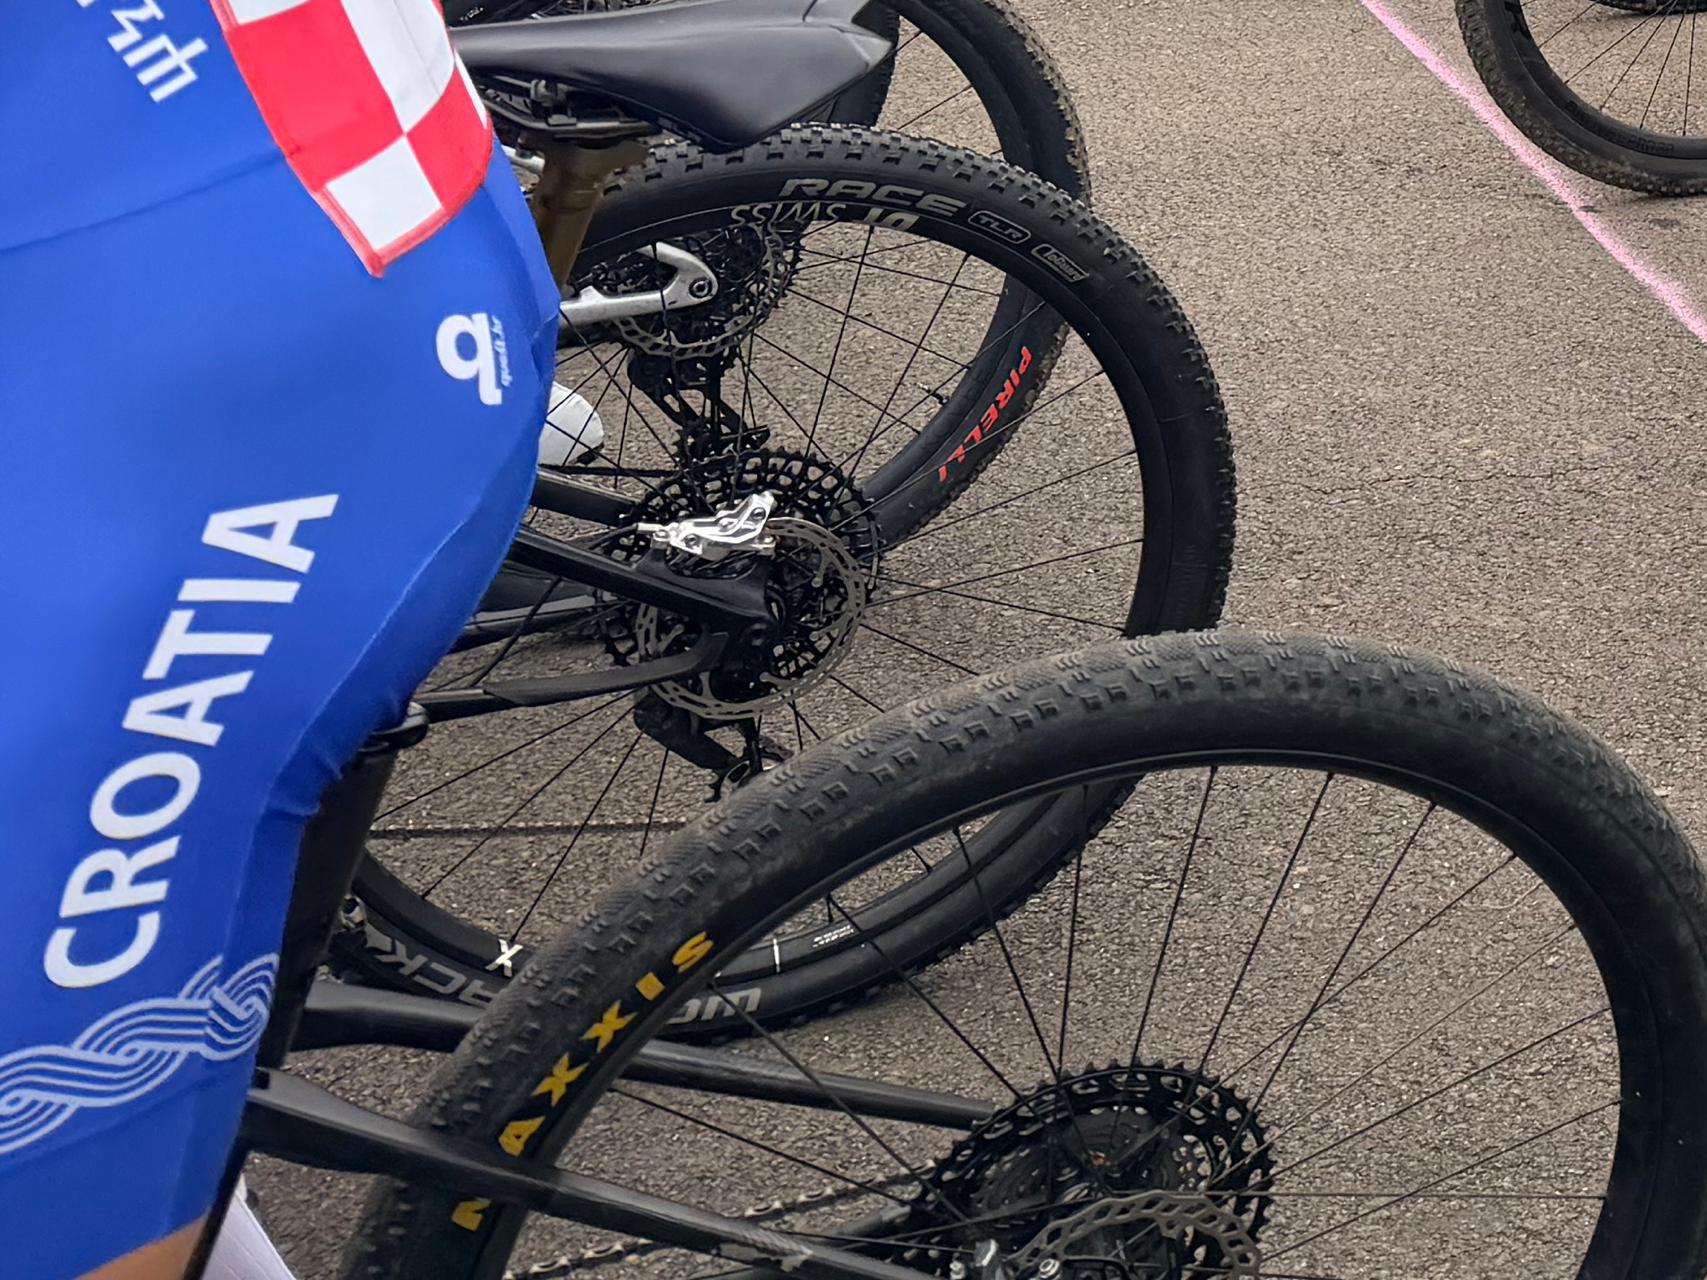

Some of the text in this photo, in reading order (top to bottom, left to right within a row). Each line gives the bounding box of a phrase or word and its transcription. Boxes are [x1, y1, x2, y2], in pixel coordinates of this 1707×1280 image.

[780, 177, 967, 215] RACE
[937, 345, 1032, 481] PIRELLI
[44, 491, 340, 989] CROATIA
